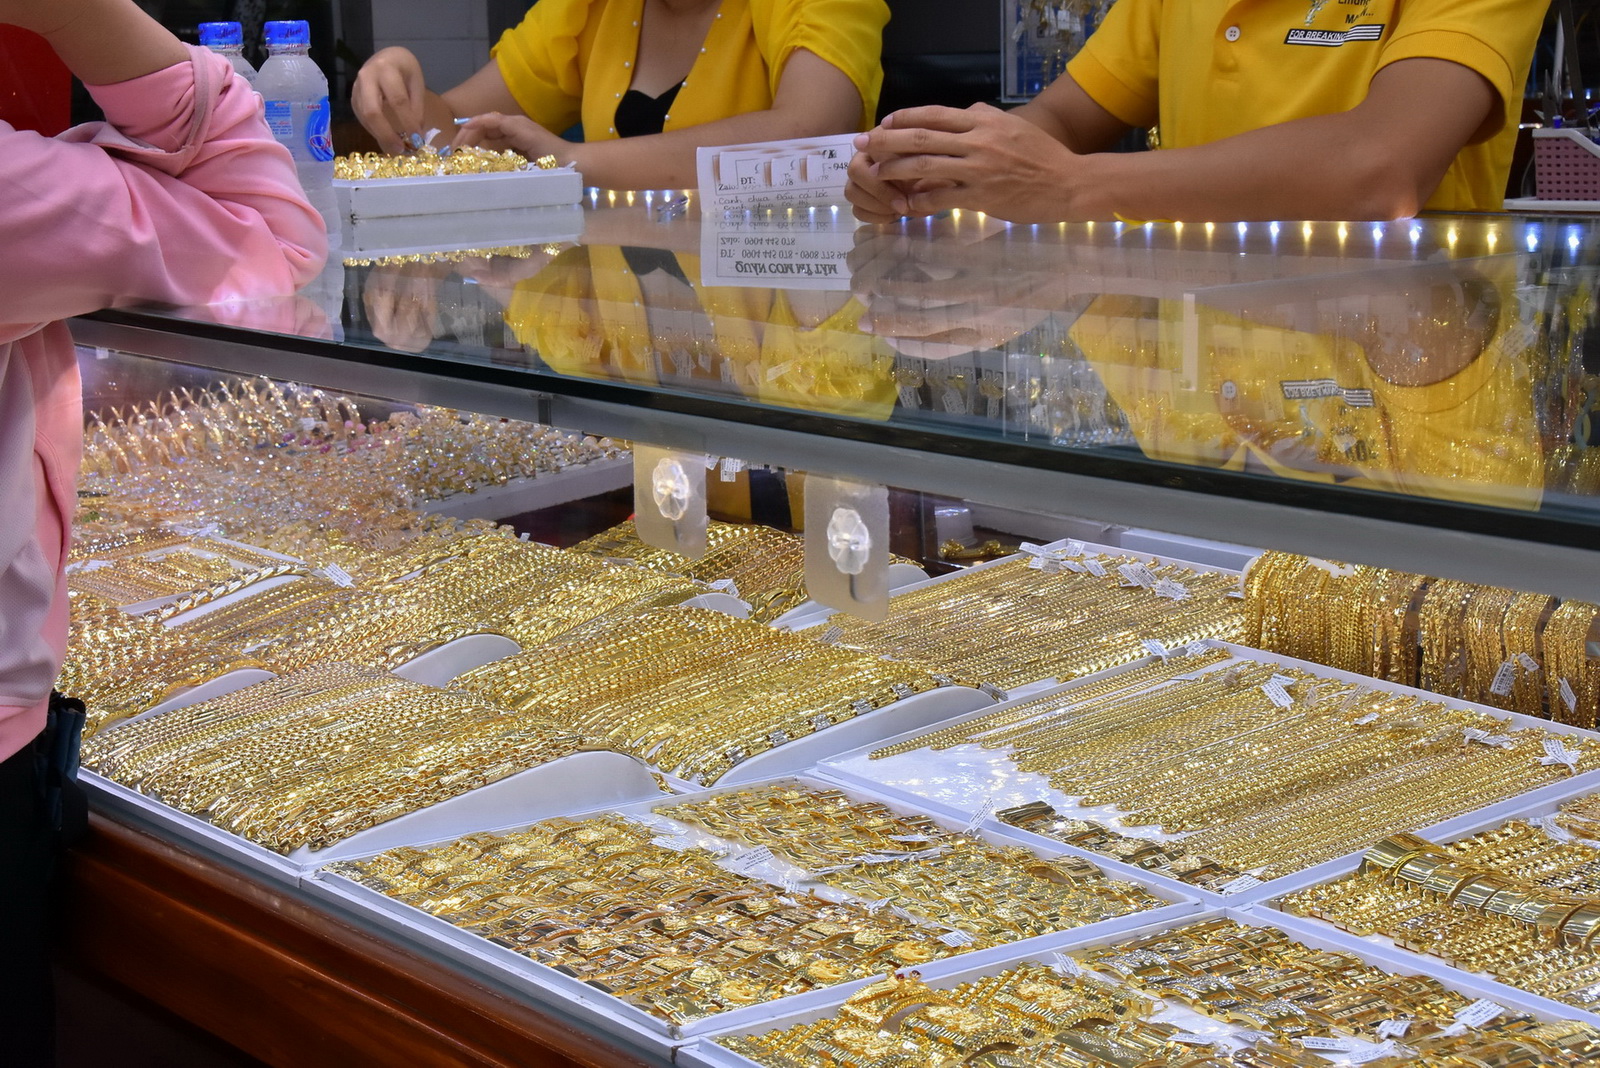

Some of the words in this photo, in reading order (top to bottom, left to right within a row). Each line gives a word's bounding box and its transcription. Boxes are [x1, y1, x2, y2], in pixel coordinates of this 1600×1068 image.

[1288, 30, 1305, 39] FOR
[1305, 31, 1347, 41] BREAKING
[740, 177, 756, 185] ĐT:
